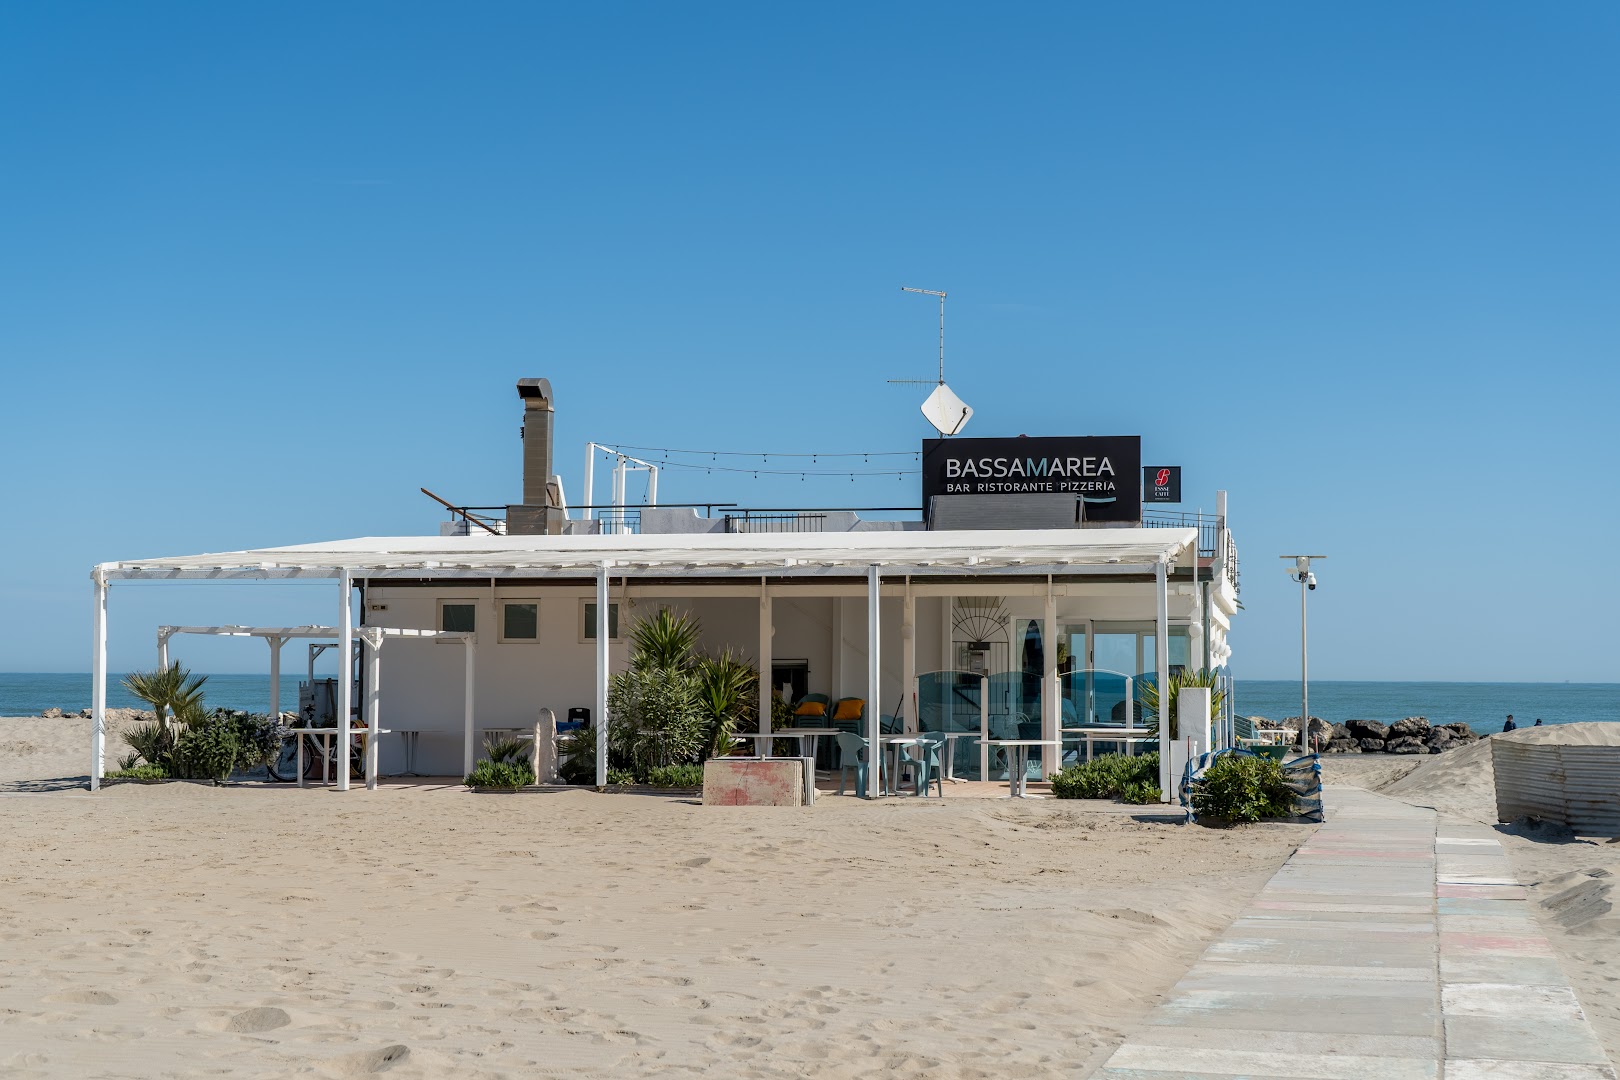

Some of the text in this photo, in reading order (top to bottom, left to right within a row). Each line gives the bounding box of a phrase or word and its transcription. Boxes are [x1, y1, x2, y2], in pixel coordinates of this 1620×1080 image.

[946, 456, 1116, 478] BASSAMAREA
[946, 481, 1116, 493] BAR RISTORANTE PIZZERIA
